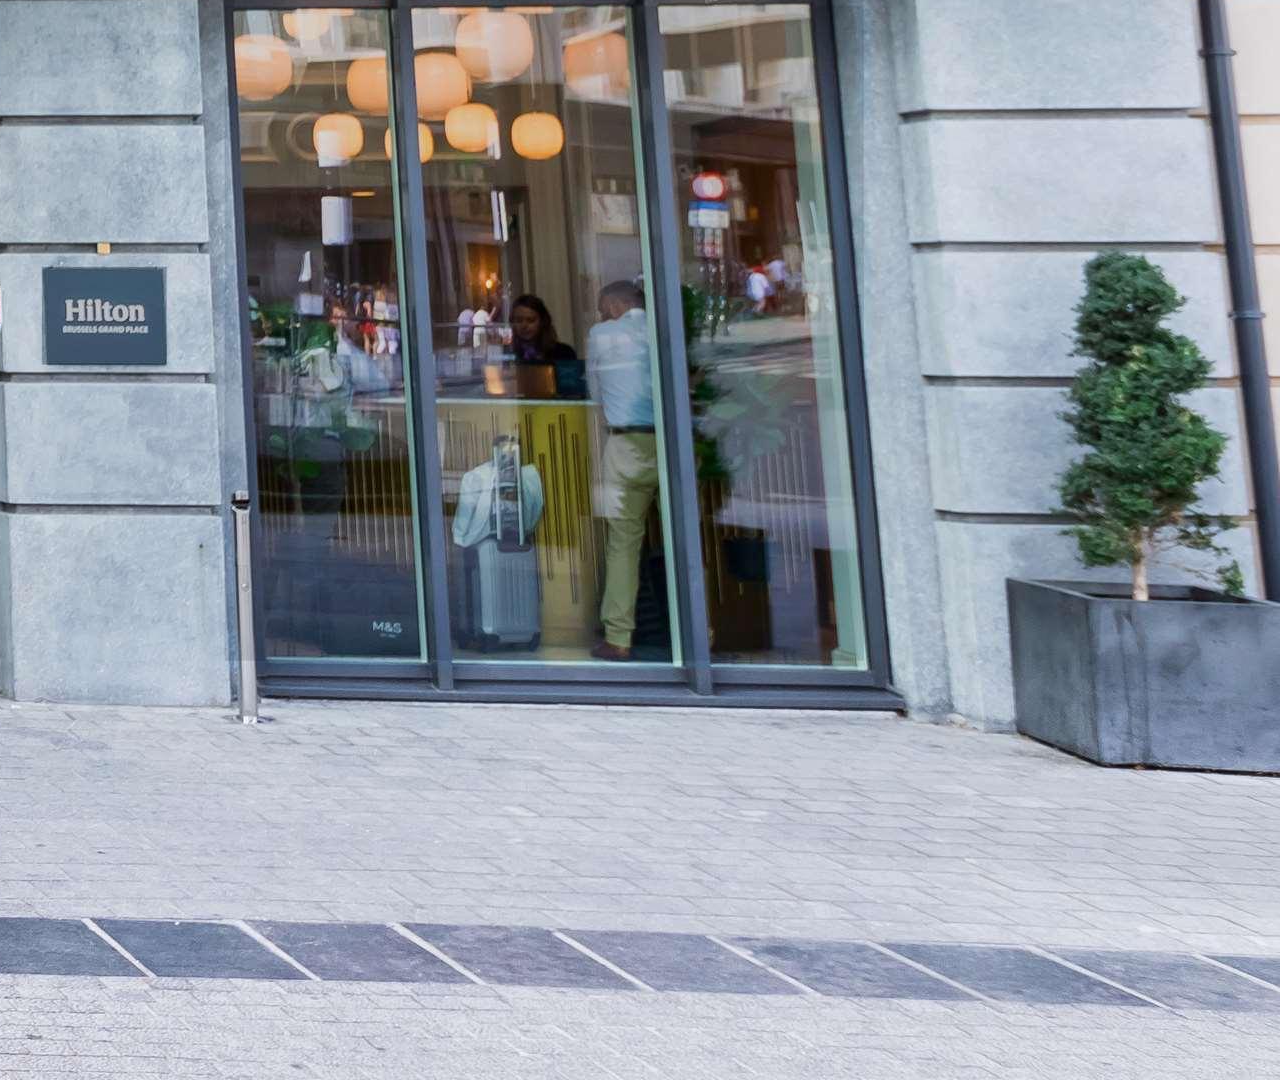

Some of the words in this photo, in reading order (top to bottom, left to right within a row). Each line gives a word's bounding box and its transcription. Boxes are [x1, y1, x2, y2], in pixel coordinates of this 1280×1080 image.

[64, 298, 146, 322] Hilton
[62, 324, 98, 334] BRUSSELS
[98, 324, 125, 334] GRAND
[125, 324, 149, 334] PLACE
[372, 621, 402, 634] M&S
